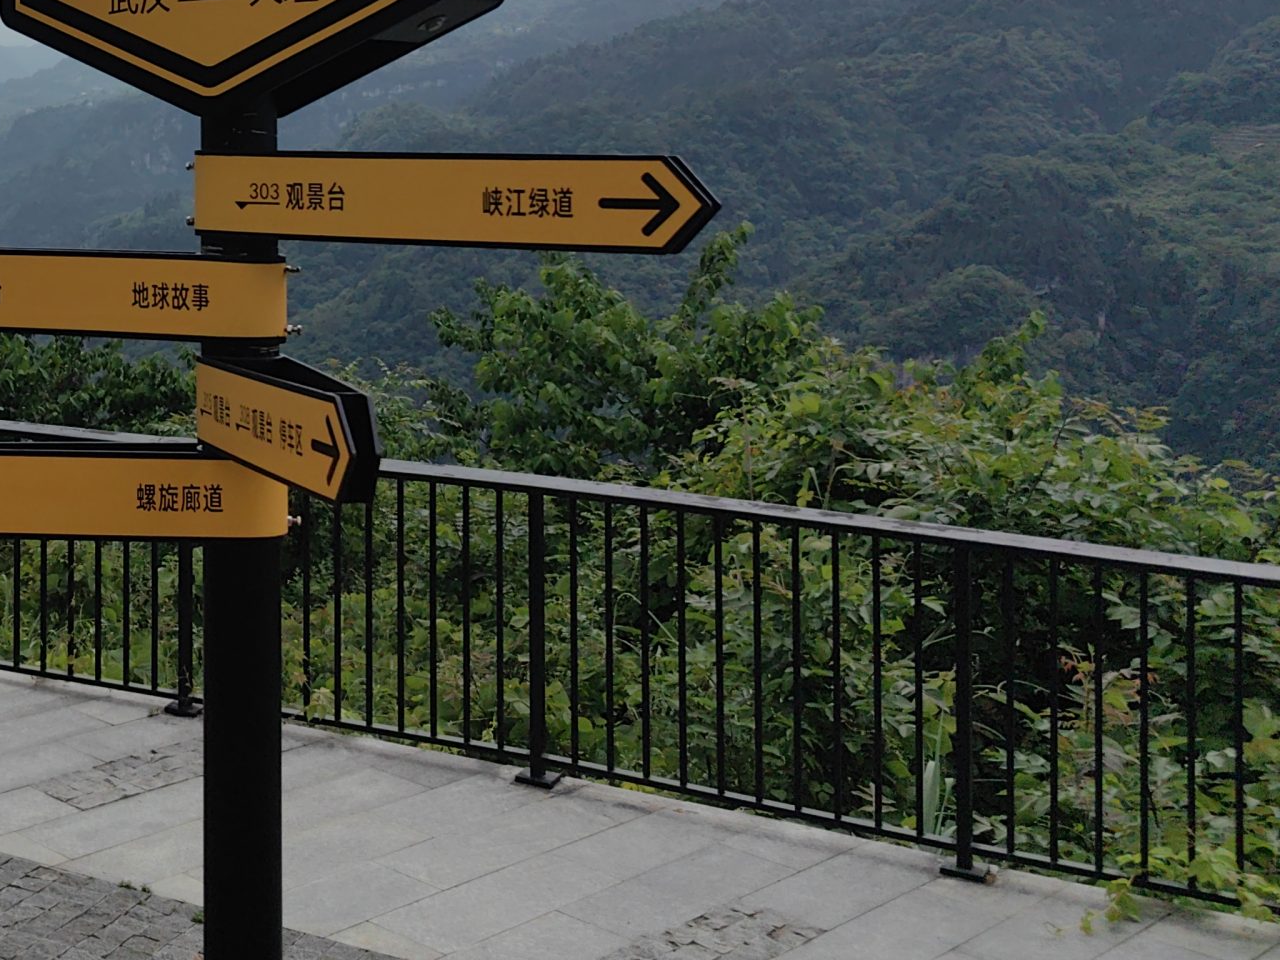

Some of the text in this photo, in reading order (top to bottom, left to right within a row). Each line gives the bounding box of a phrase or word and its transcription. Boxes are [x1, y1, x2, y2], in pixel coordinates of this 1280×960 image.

[482, 187, 574, 218] 峡江绿道
[131, 281, 210, 311] 地球故事
[136, 483, 224, 513] 螺旋廊道
